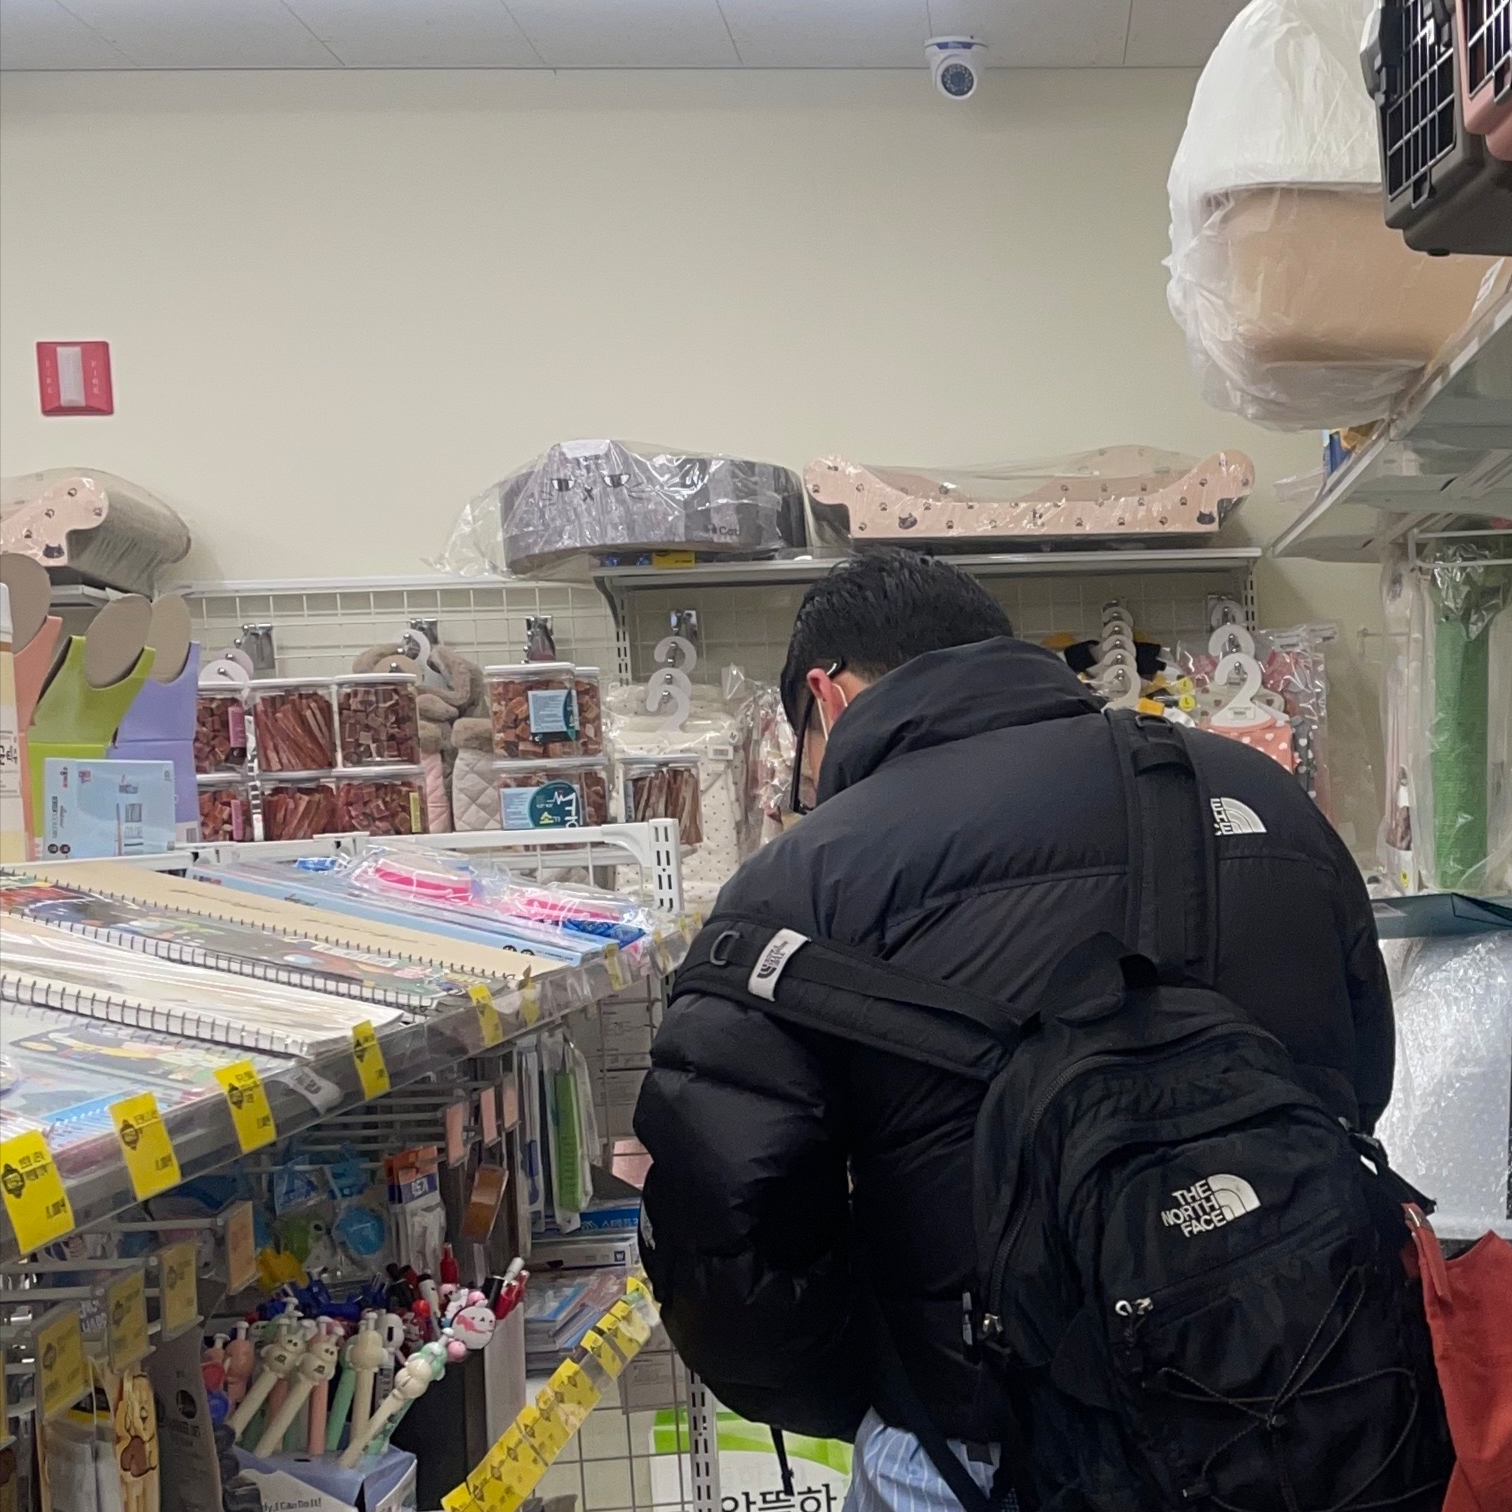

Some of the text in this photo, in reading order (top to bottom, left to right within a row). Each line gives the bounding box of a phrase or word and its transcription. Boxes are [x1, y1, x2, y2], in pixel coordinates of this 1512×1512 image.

[1172, 1180, 1211, 1205] THE
[1161, 1195, 1220, 1226] NORTH
[1181, 1210, 1227, 1237] FACE
